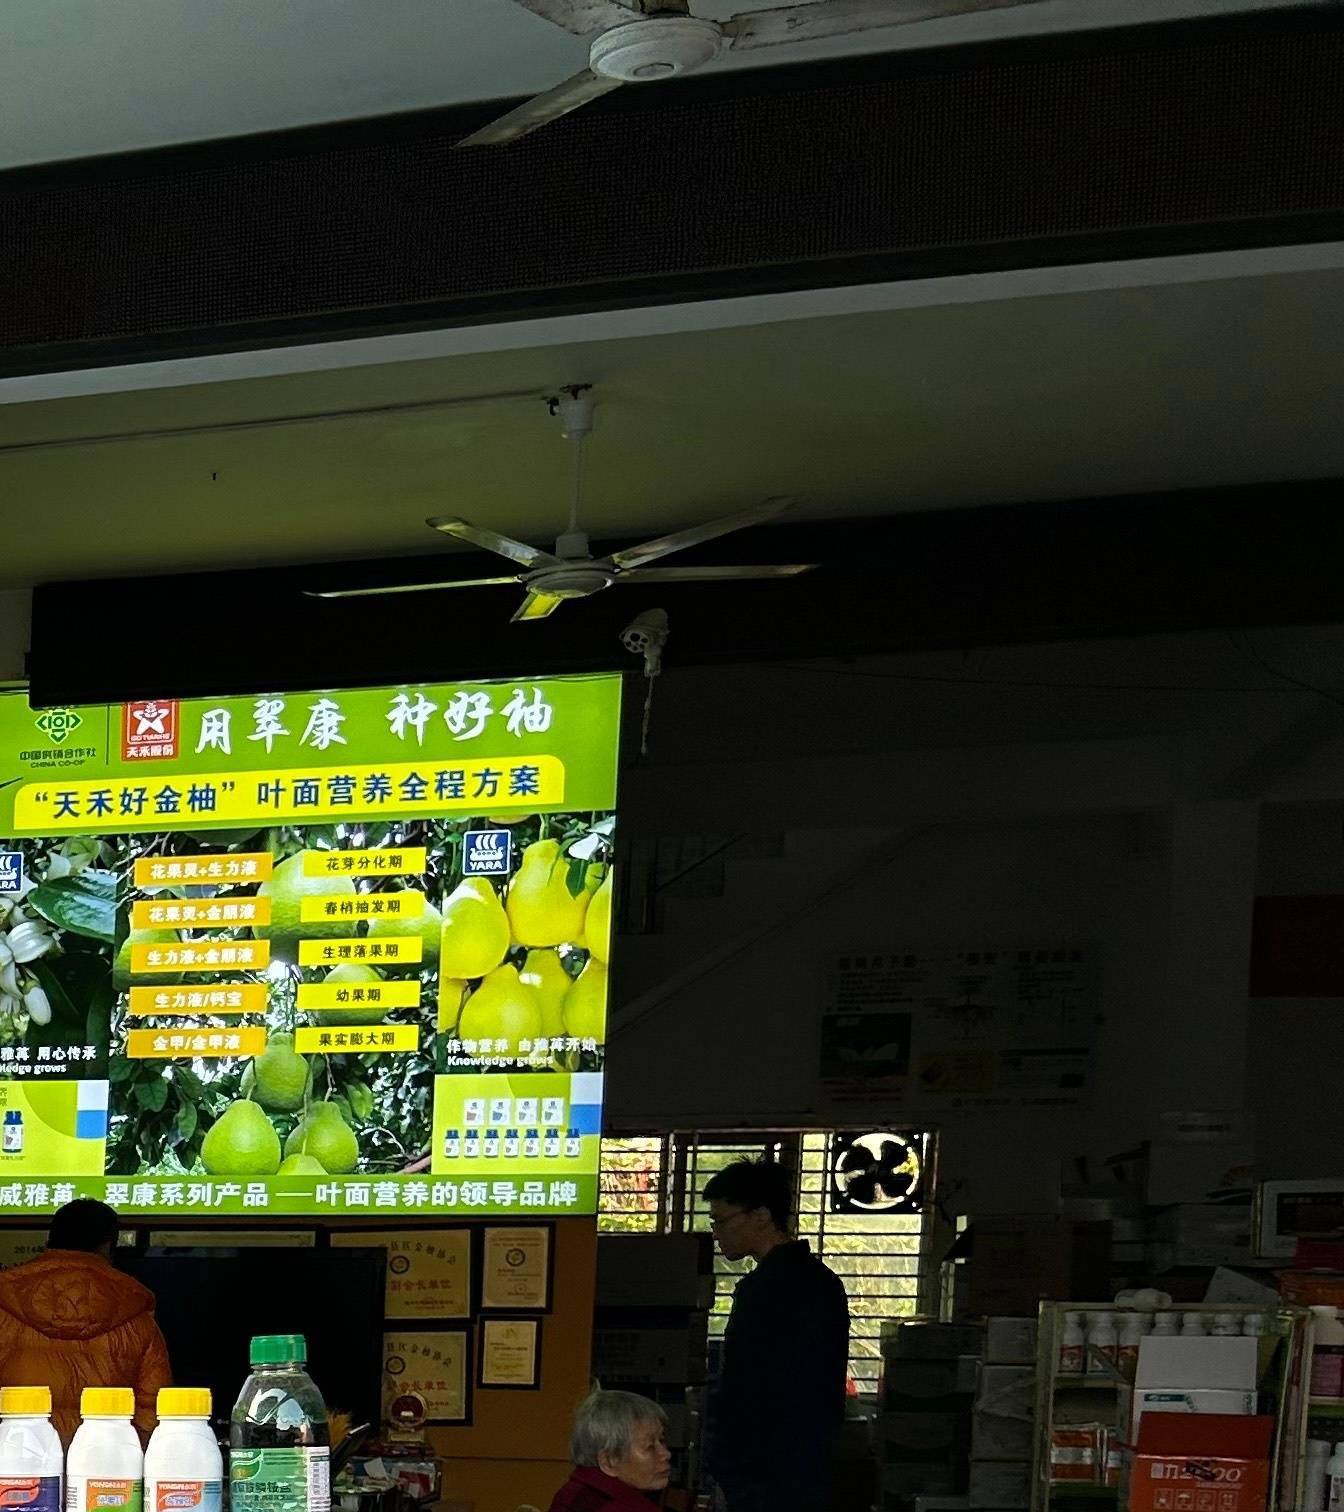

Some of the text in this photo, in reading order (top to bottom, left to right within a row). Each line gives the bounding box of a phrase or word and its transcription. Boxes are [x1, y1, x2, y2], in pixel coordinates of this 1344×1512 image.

[195, 688, 553, 755] 用翠康 种好柚
[19, 746, 97, 763] 中国供销合作社
[125, 744, 174, 759] 天禾股份
[257, 766, 541, 808] 叶面营养全程方案
[325, 852, 403, 872] 花芽分化期
[469, 859, 504, 872] YARA
[322, 941, 399, 960] 生理落果期
[336, 986, 381, 1005] 幼果期
[318, 1029, 396, 1048] 果实膨大期
[37, 1045, 97, 1061] 用心传承
[447, 1053, 554, 1068] Knowledge grows
[33, 1064, 67, 1075] grows
[106, 1181, 269, 1207] 翠康系列产品
[314, 1180, 578, 1206] 叶面营养的领导品牌
